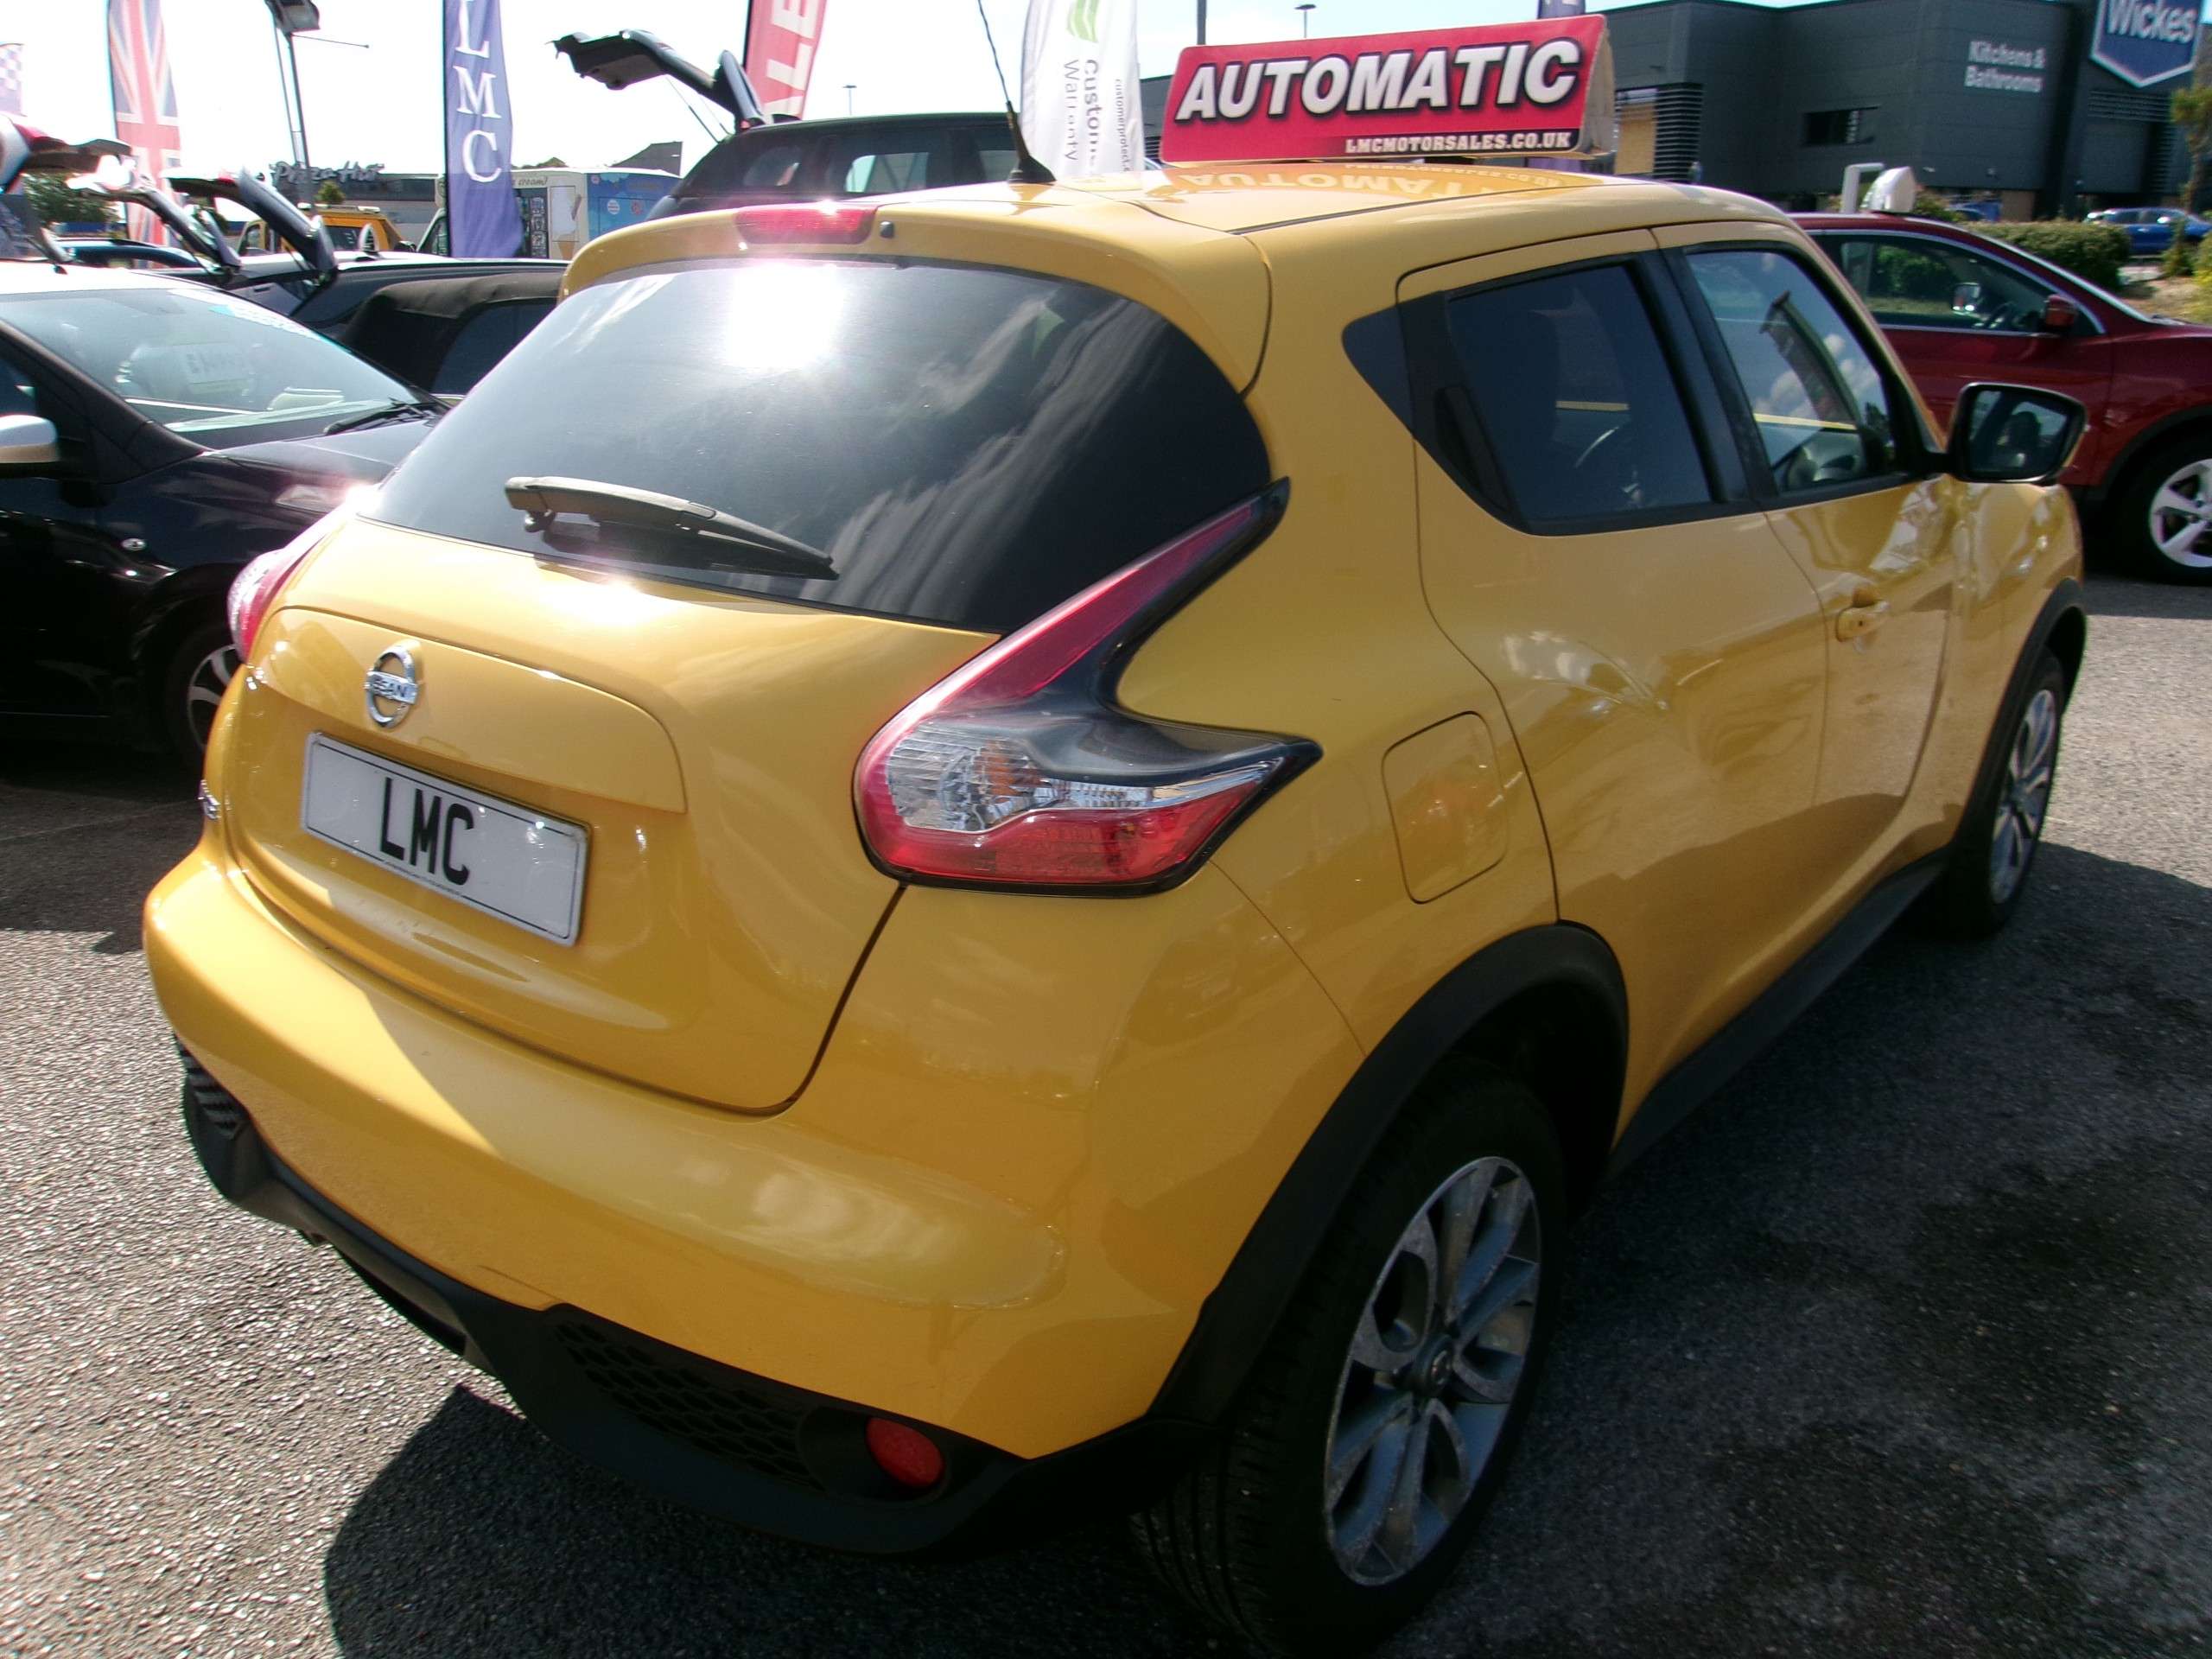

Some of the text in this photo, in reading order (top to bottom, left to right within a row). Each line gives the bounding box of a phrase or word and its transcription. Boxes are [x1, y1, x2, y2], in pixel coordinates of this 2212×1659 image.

[2107, 0, 2198, 43] Wickes
[1969, 41, 2032, 67] Kitchens
[453, 0, 502, 183] LMC
[1175, 37, 1580, 121] AUTOMATIC
[1964, 65, 2042, 92] Bathrooms
[1345, 132, 1572, 154] LMCMOTORSALES.CO.UK
[379, 777, 474, 887] LMC
